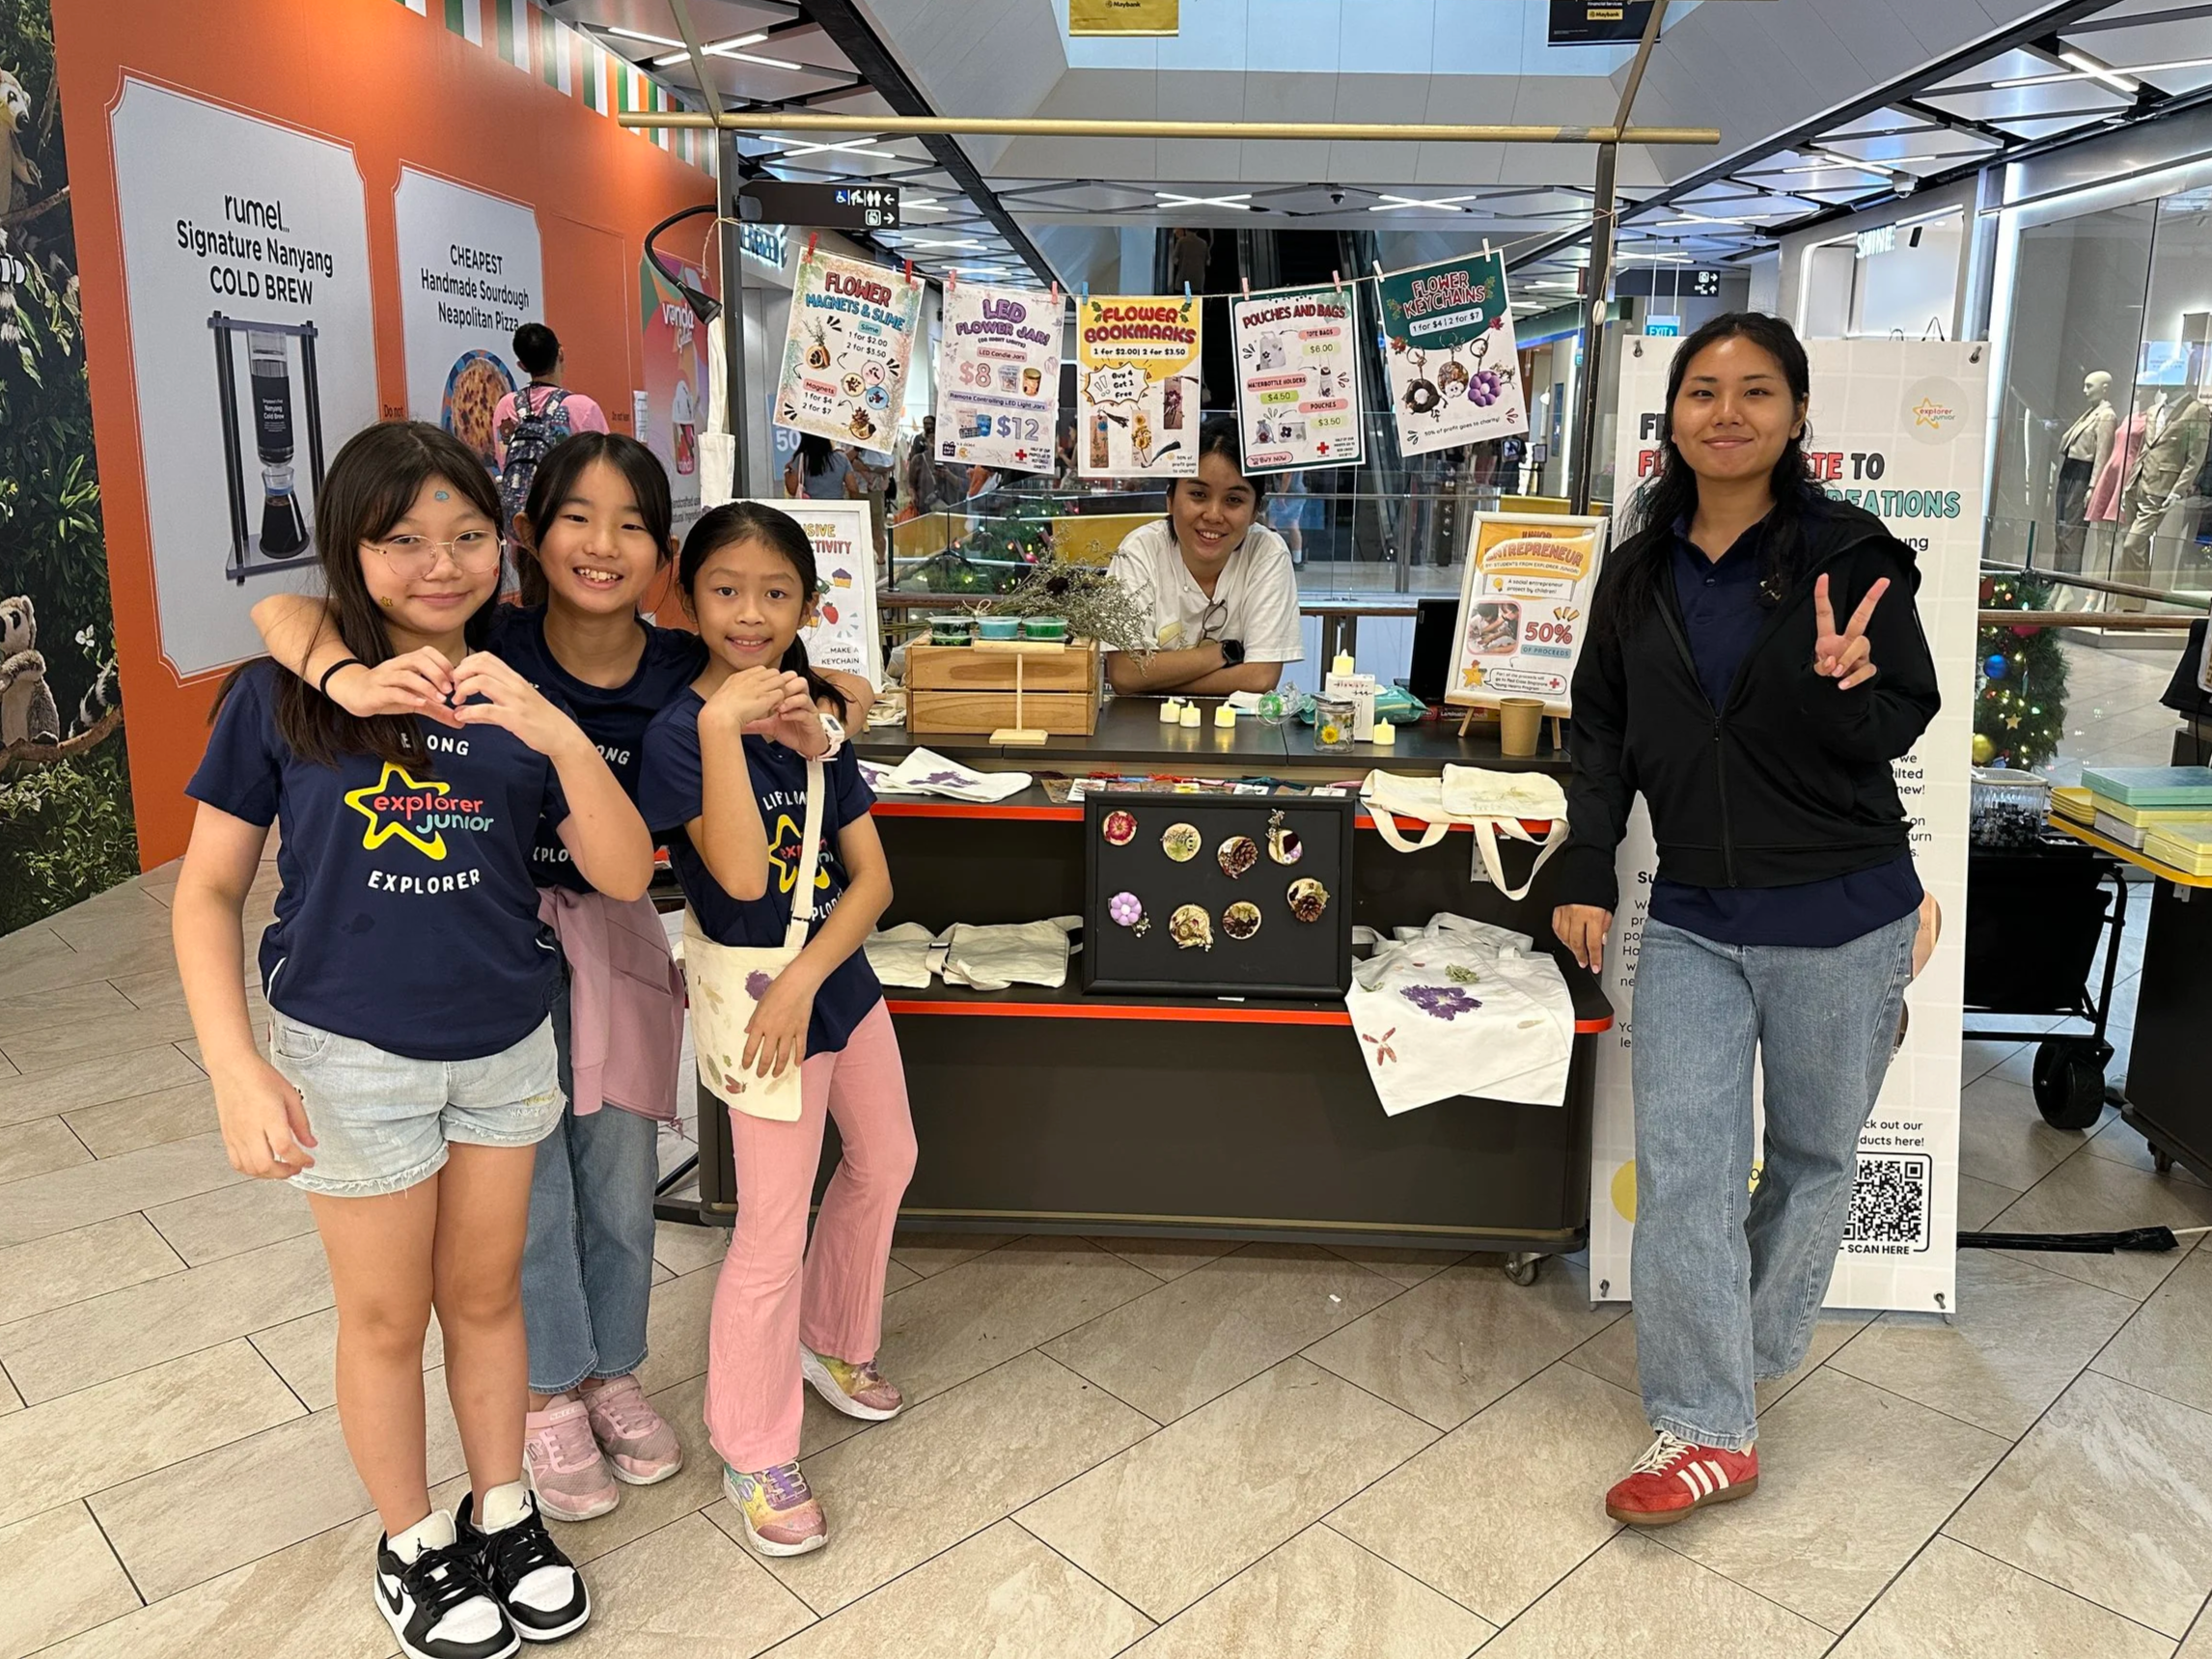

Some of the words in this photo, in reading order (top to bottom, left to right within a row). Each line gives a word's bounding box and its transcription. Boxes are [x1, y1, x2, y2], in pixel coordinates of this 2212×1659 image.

[177, 219, 263, 262] Signature
[266, 237, 333, 278] Nanyang
[450, 244, 503, 275] CHEAPEST
[209, 265, 260, 298] COLD
[264, 274, 313, 305] BREW
[421, 267, 477, 298] Handmade
[480, 280, 529, 311] Sourdough
[825, 271, 892, 308] FLOWER
[1412, 271, 1469, 298] FLOWER
[982, 299, 1026, 323] LED
[1403, 286, 1485, 319] KEYCHAINS
[438, 301, 493, 329] Neapolitan
[495, 311, 518, 332] Pizza
[806, 293, 860, 315] MAGNETS
[861, 304, 871, 318] &
[871, 308, 905, 331] SLIME
[1102, 306, 1178, 323] FLOWER
[1242, 306, 1292, 329] POUCHES
[1293, 304, 1316, 318] AND
[1316, 303, 1346, 318] BAGS
[1470, 312, 1479, 320] $7
[861, 323, 879, 334] Slime
[955, 321, 1013, 336] FLOWER
[1016, 326, 1051, 346] JAR!
[1084, 324, 1197, 345] BOOKMARKS
[1649, 326, 1669, 336] EXIT
[854, 332, 865, 341] for
[867, 336, 888, 347] $2.00
[1310, 344, 1333, 353] $6.00
[867, 347, 886, 358] $3.50
[959, 361, 991, 388] $8
[1248, 378, 1283, 388] WATERBOTTLE
[1283, 376, 1306, 385] HOLDERS
[806, 381, 835, 395] Magnets
[810, 393, 821, 401] for
[1268, 392, 1290, 401] $4.50
[809, 403, 820, 412] for
[950, 393, 972, 401] Remote
[973, 396, 1004, 405] Controlling
[1920, 407, 1952, 416] explorer
[996, 415, 1039, 441] $12
[1318, 417, 1341, 427] $3.50
[1851, 453, 1885, 480] TO
[1525, 622, 1573, 645] 50%
[1899, 755, 1918, 763] we
[1894, 768, 1923, 779] ilted
[373, 792, 484, 820] explorer
[416, 814, 494, 834] junior
[368, 869, 480, 895] EXPLORER
[1880, 1120, 1899, 1130] out
[1894, 1137, 1924, 1147] here!
[1847, 1244, 1879, 1254] SCAN
[1882, 1246, 1910, 1255] HERE
